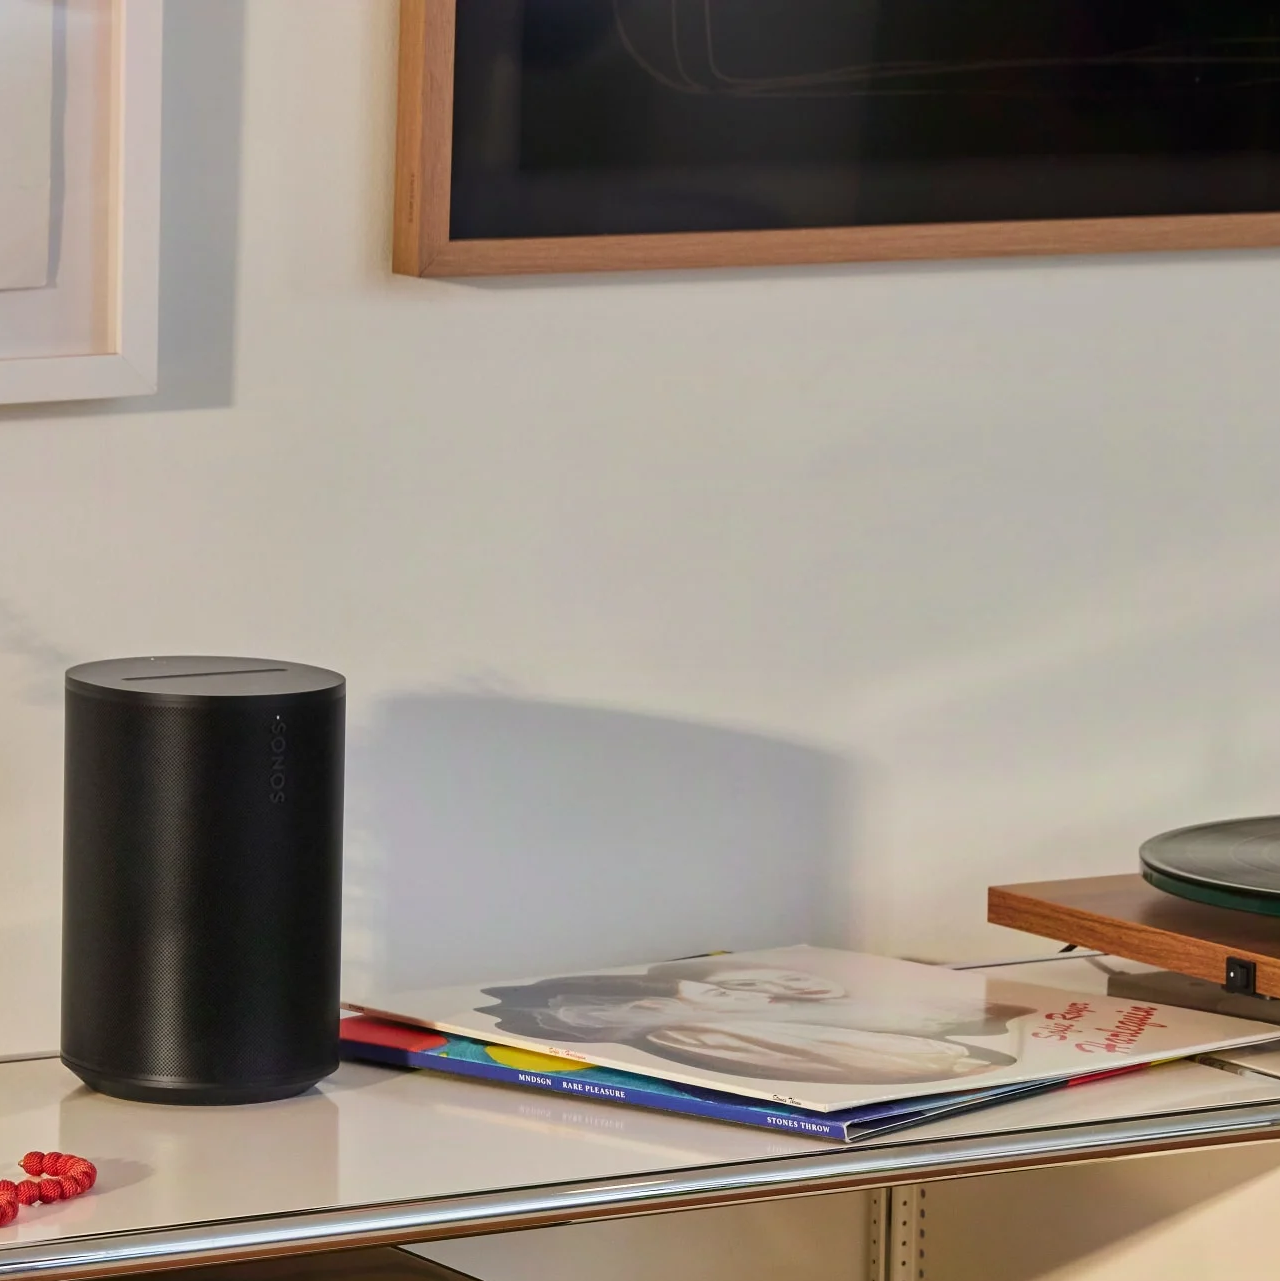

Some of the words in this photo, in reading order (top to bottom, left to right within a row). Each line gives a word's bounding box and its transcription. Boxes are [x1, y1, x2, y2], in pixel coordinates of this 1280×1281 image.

[267, 721, 288, 804] SONOS
[517, 1073, 552, 1086] MNDSGN
[560, 1080, 584, 1091] RARE
[584, 1084, 626, 1099] PLEASURE
[766, 1114, 799, 1128] STONES
[798, 1120, 830, 1133] THROW
